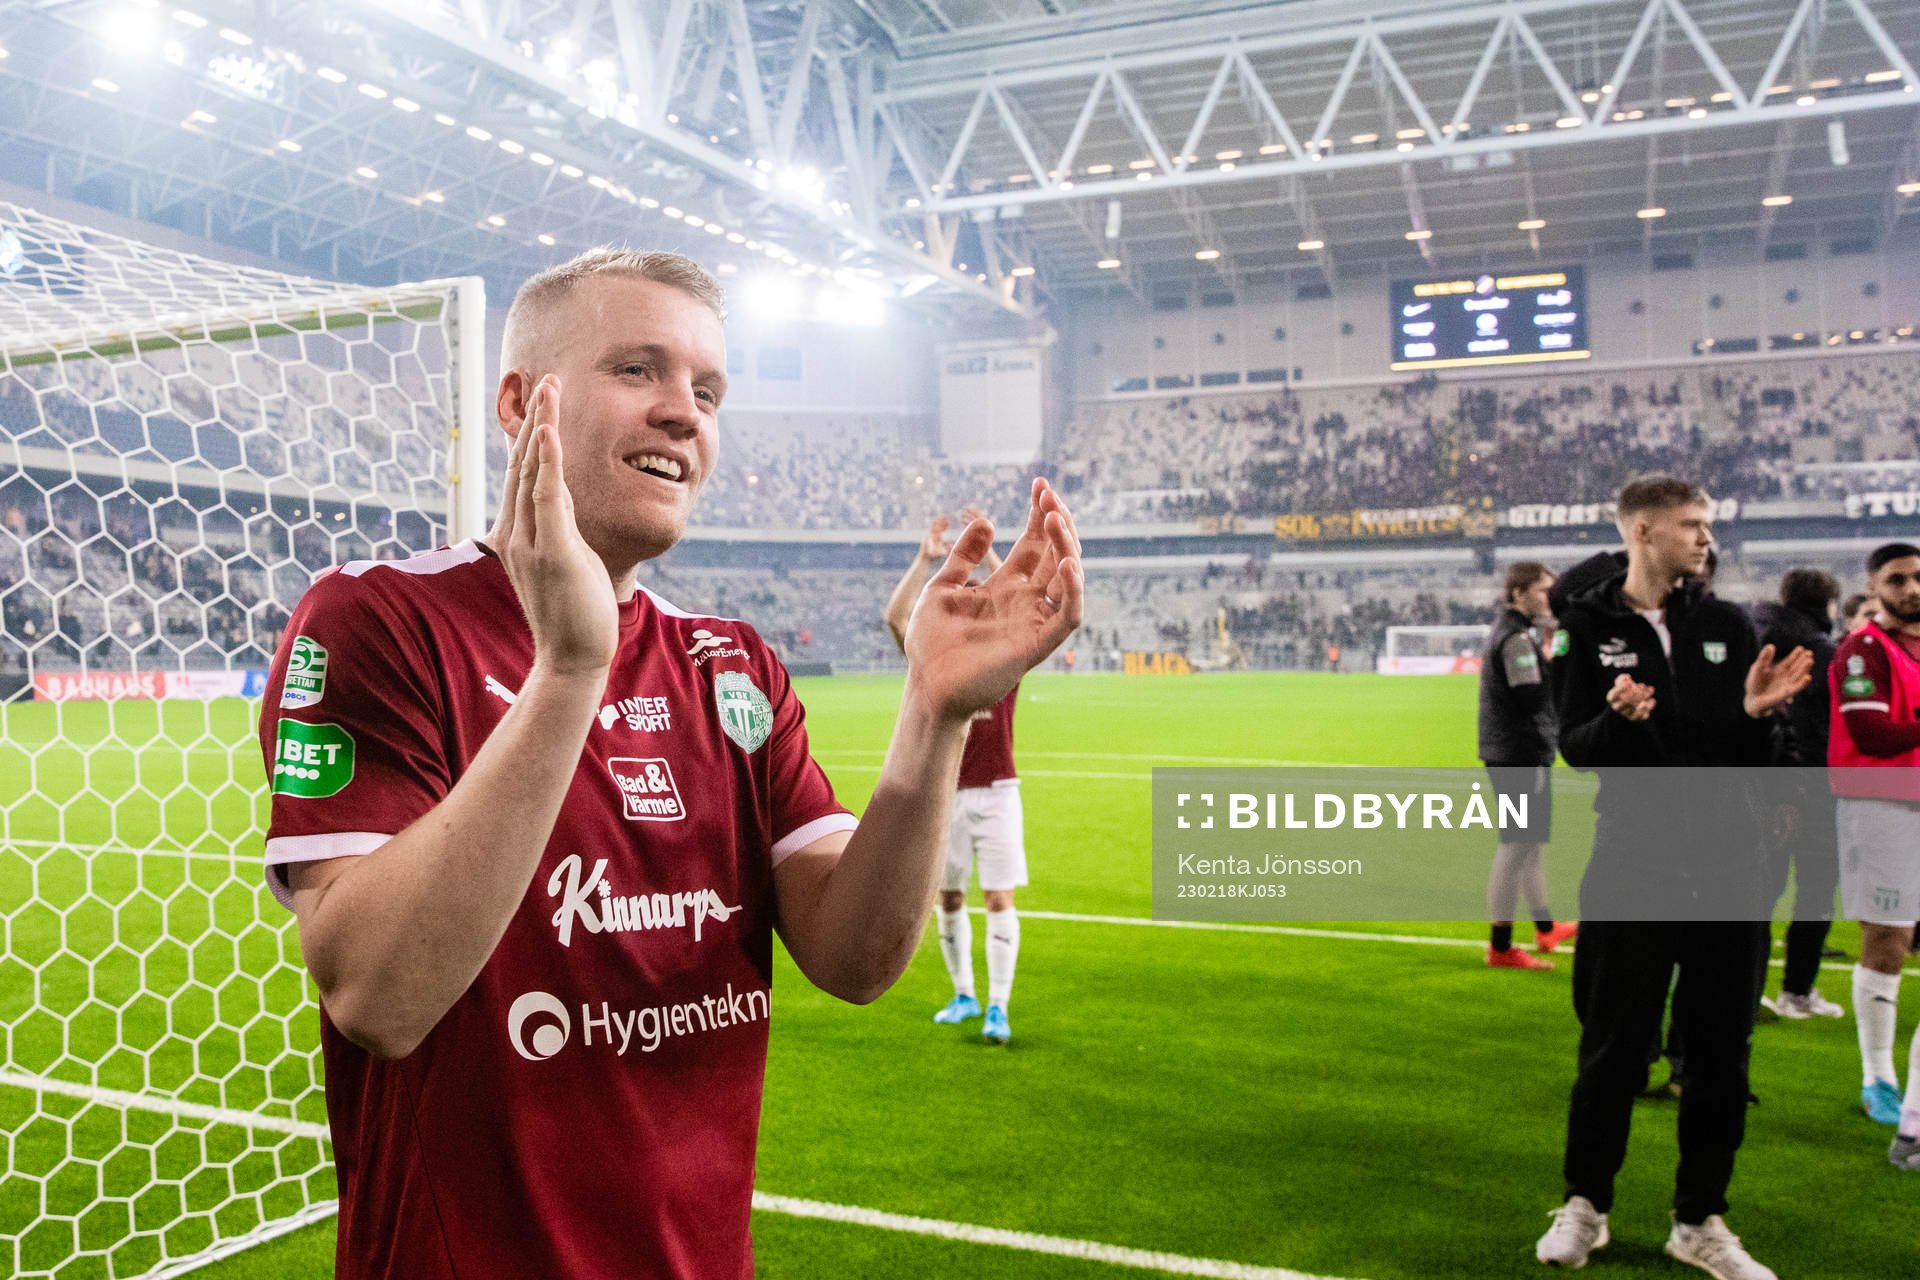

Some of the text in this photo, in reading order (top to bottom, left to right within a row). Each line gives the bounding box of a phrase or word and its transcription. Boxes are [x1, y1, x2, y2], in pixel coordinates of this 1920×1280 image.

[46, 676, 156, 697] BAUHAUS
[620, 697, 668, 715] INTER
[628, 713, 671, 732] SPORT
[616, 764, 670, 793] Bad &
[626, 794, 679, 814] Värme
[547, 854, 743, 947] Kinnarps
